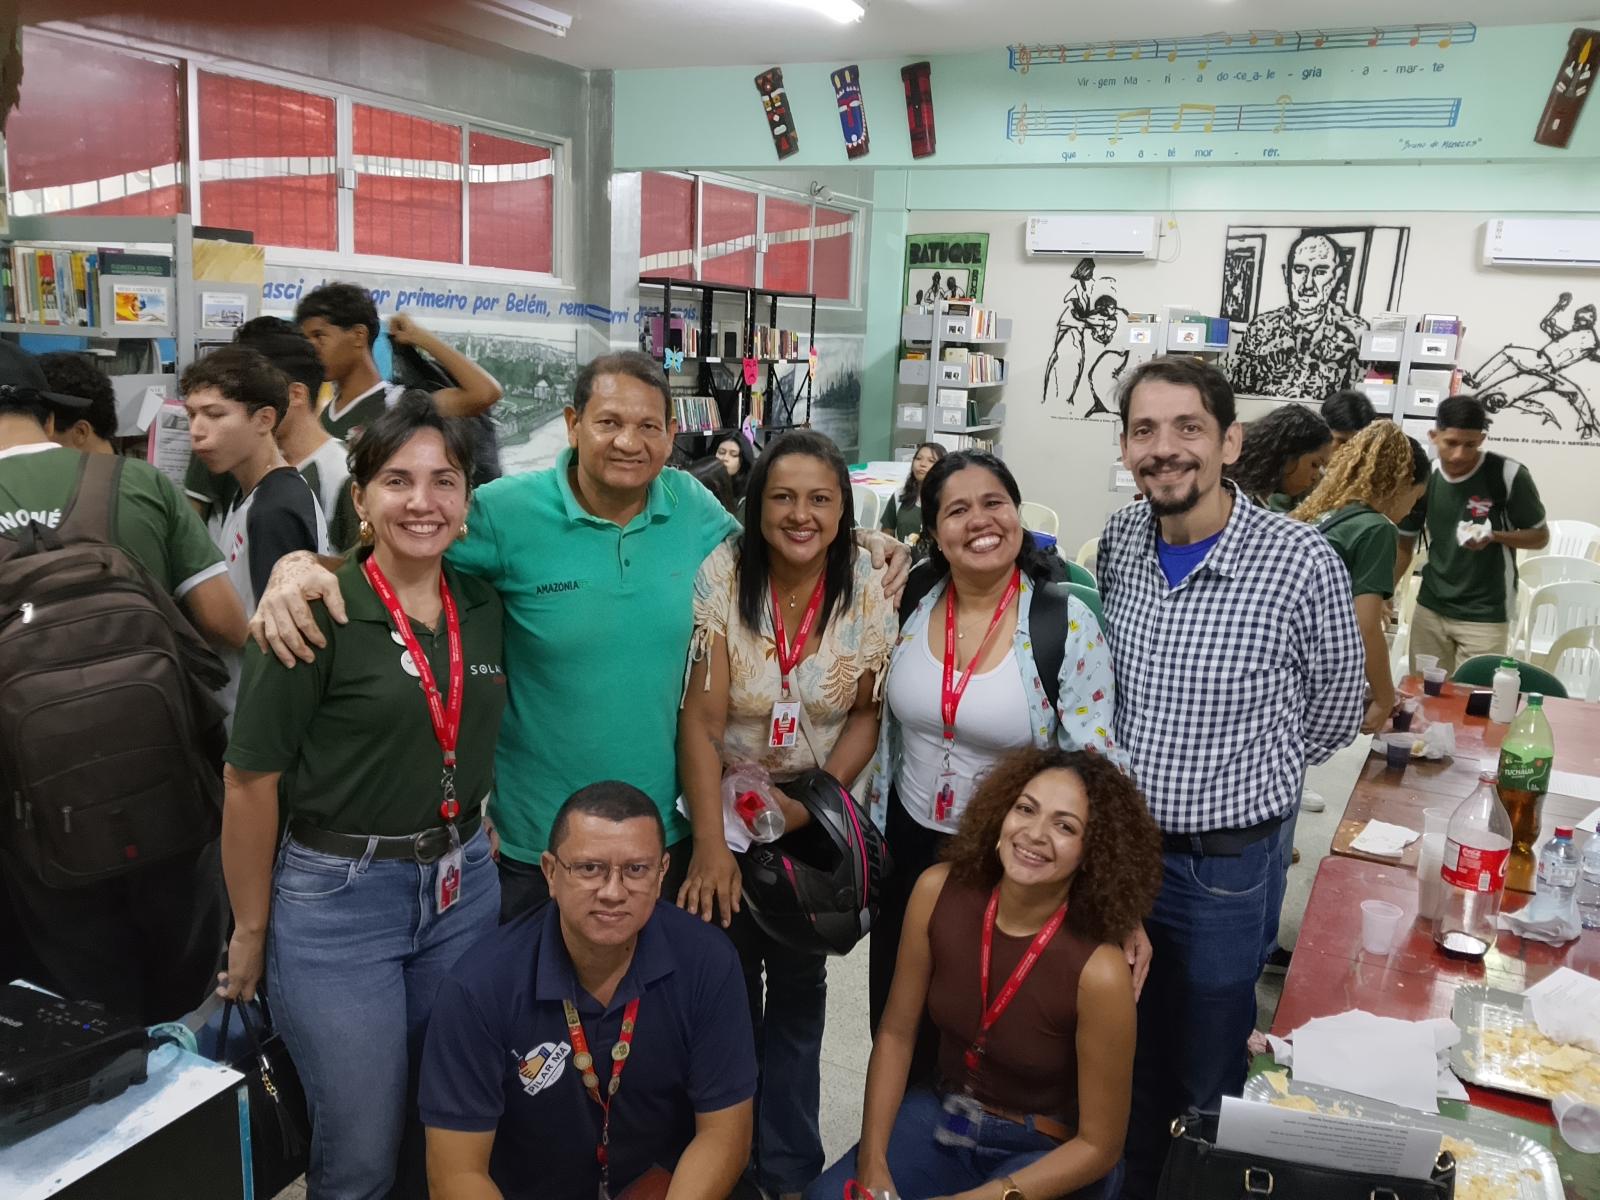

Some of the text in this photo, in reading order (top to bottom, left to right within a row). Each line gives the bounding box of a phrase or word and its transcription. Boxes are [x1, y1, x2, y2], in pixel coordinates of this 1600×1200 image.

[262, 278, 304, 299] asci
[395, 287, 468, 311] primeiro
[472, 295, 500, 315] por
[505, 292, 551, 318] Belém,
[0, 508, 62, 533] NOMÉ
[528, 1047, 568, 1093] PILAR MA
